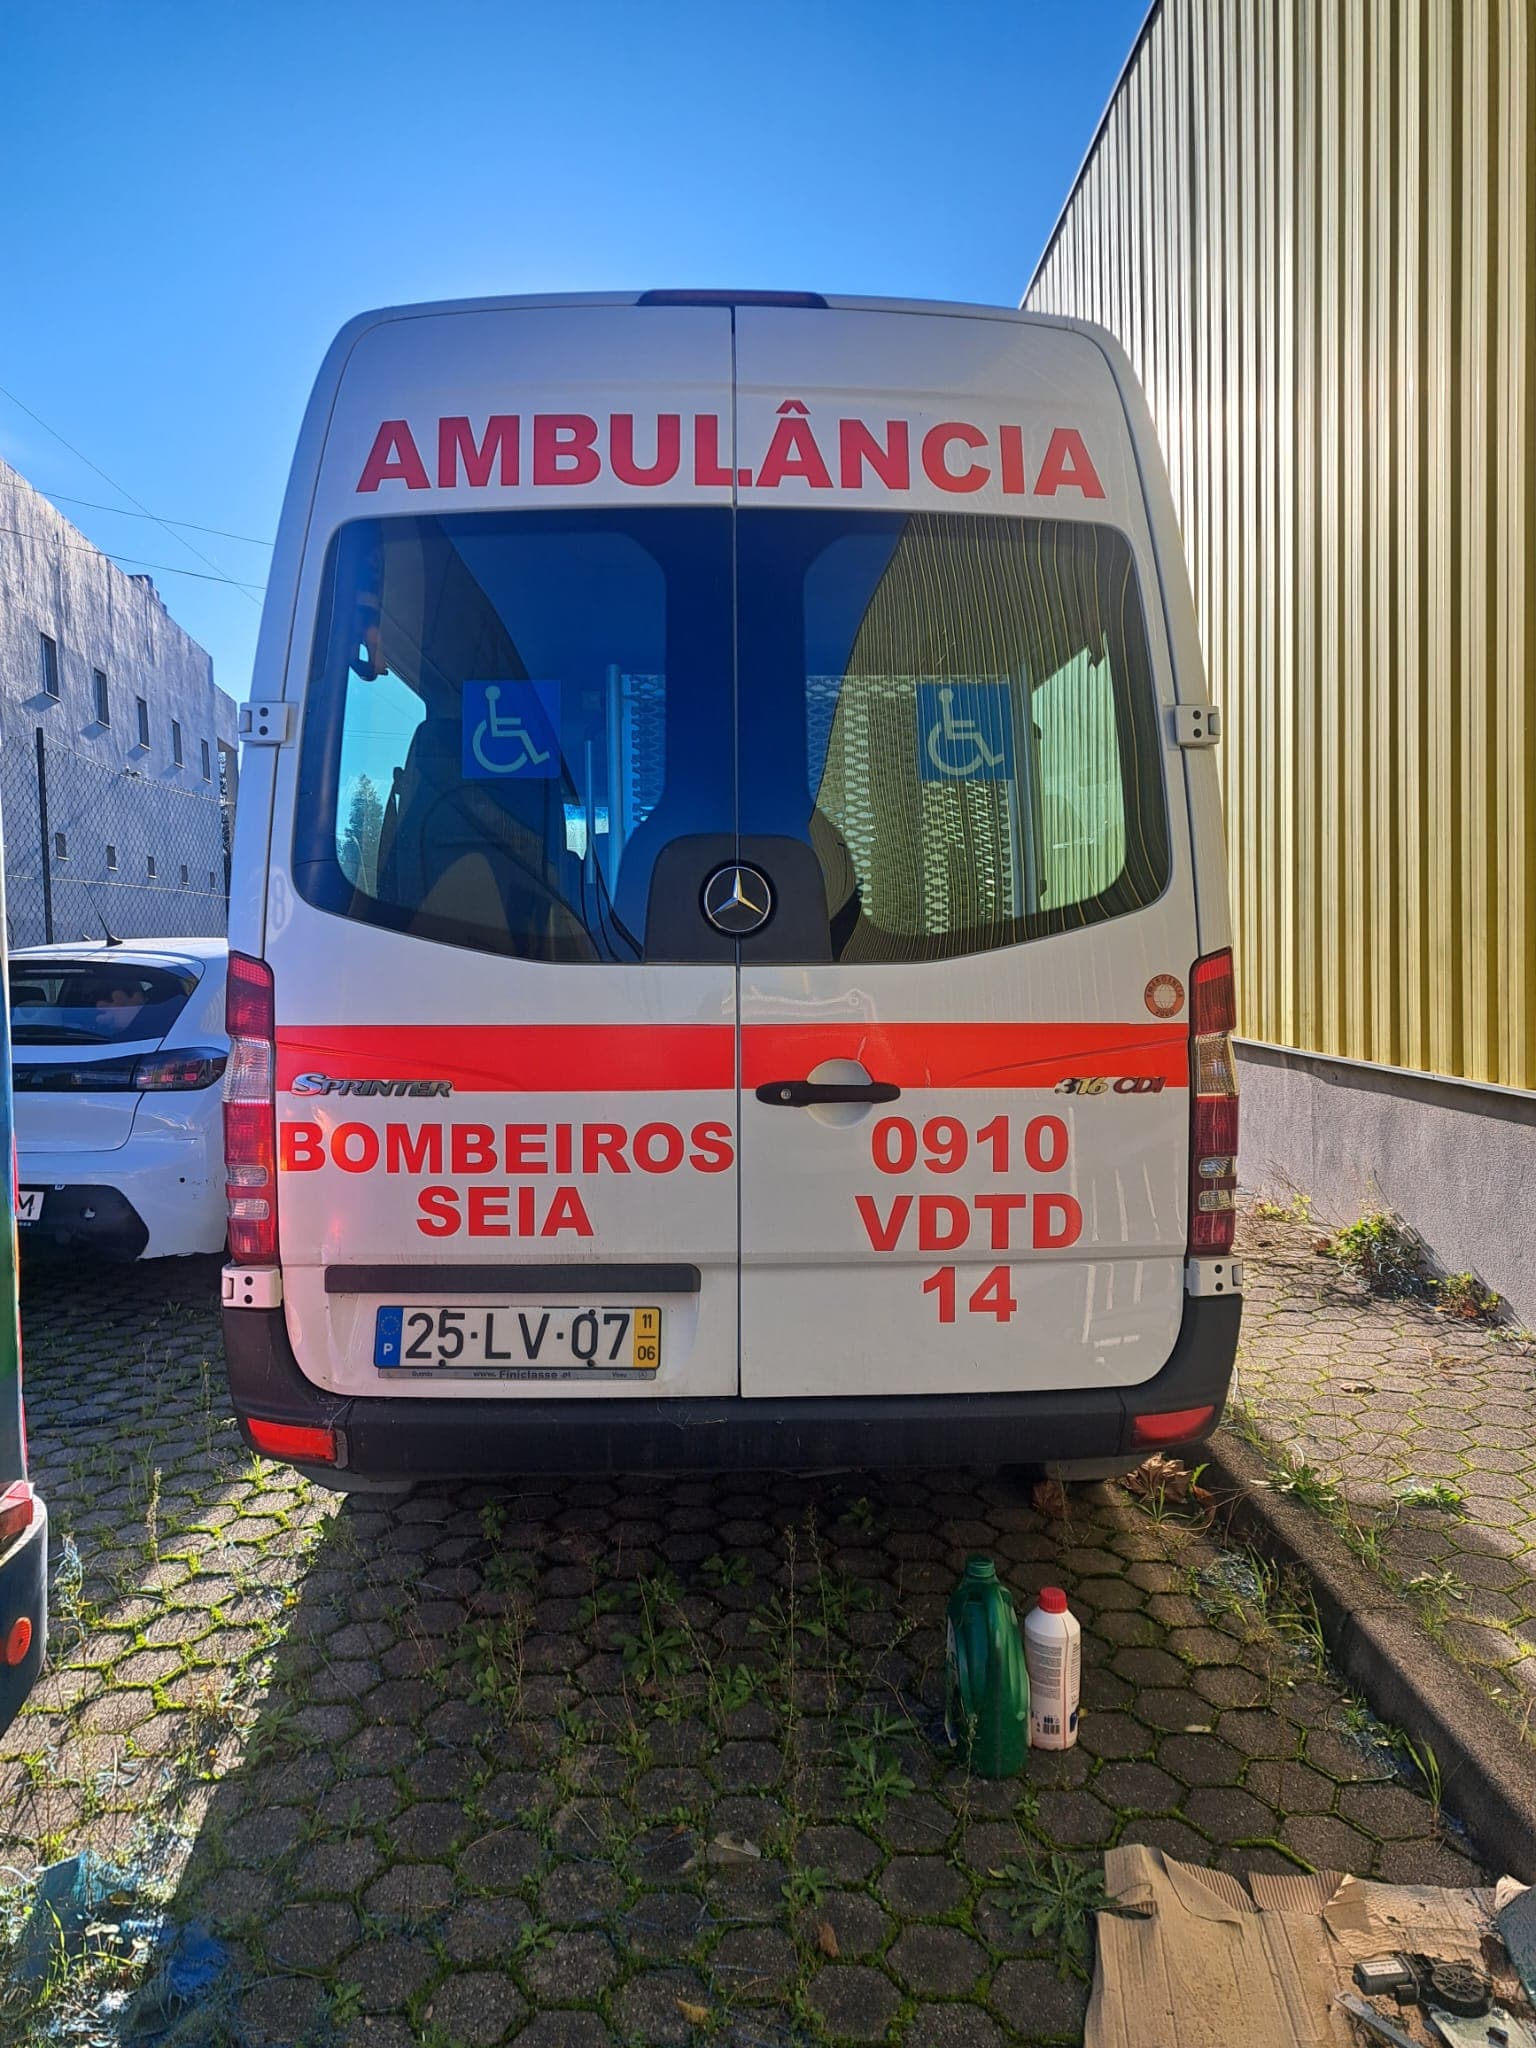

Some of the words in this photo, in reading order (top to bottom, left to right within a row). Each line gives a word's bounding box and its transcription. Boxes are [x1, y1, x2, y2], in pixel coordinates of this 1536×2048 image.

[356, 400, 1106, 498] AMBULÂNCIA
[1054, 1077, 1108, 1095] 316
[1113, 1077, 1167, 1094] CDI
[279, 1122, 735, 1175] BOMBEIROS
[871, 1115, 1069, 1175] 0910
[416, 1186, 594, 1238] SEIA
[855, 1193, 1083, 1252] VDTD
[922, 1266, 1018, 1323] 14
[642, 1313, 653, 1330] 11
[383, 1343, 394, 1356] P
[637, 1345, 656, 1361] 06
